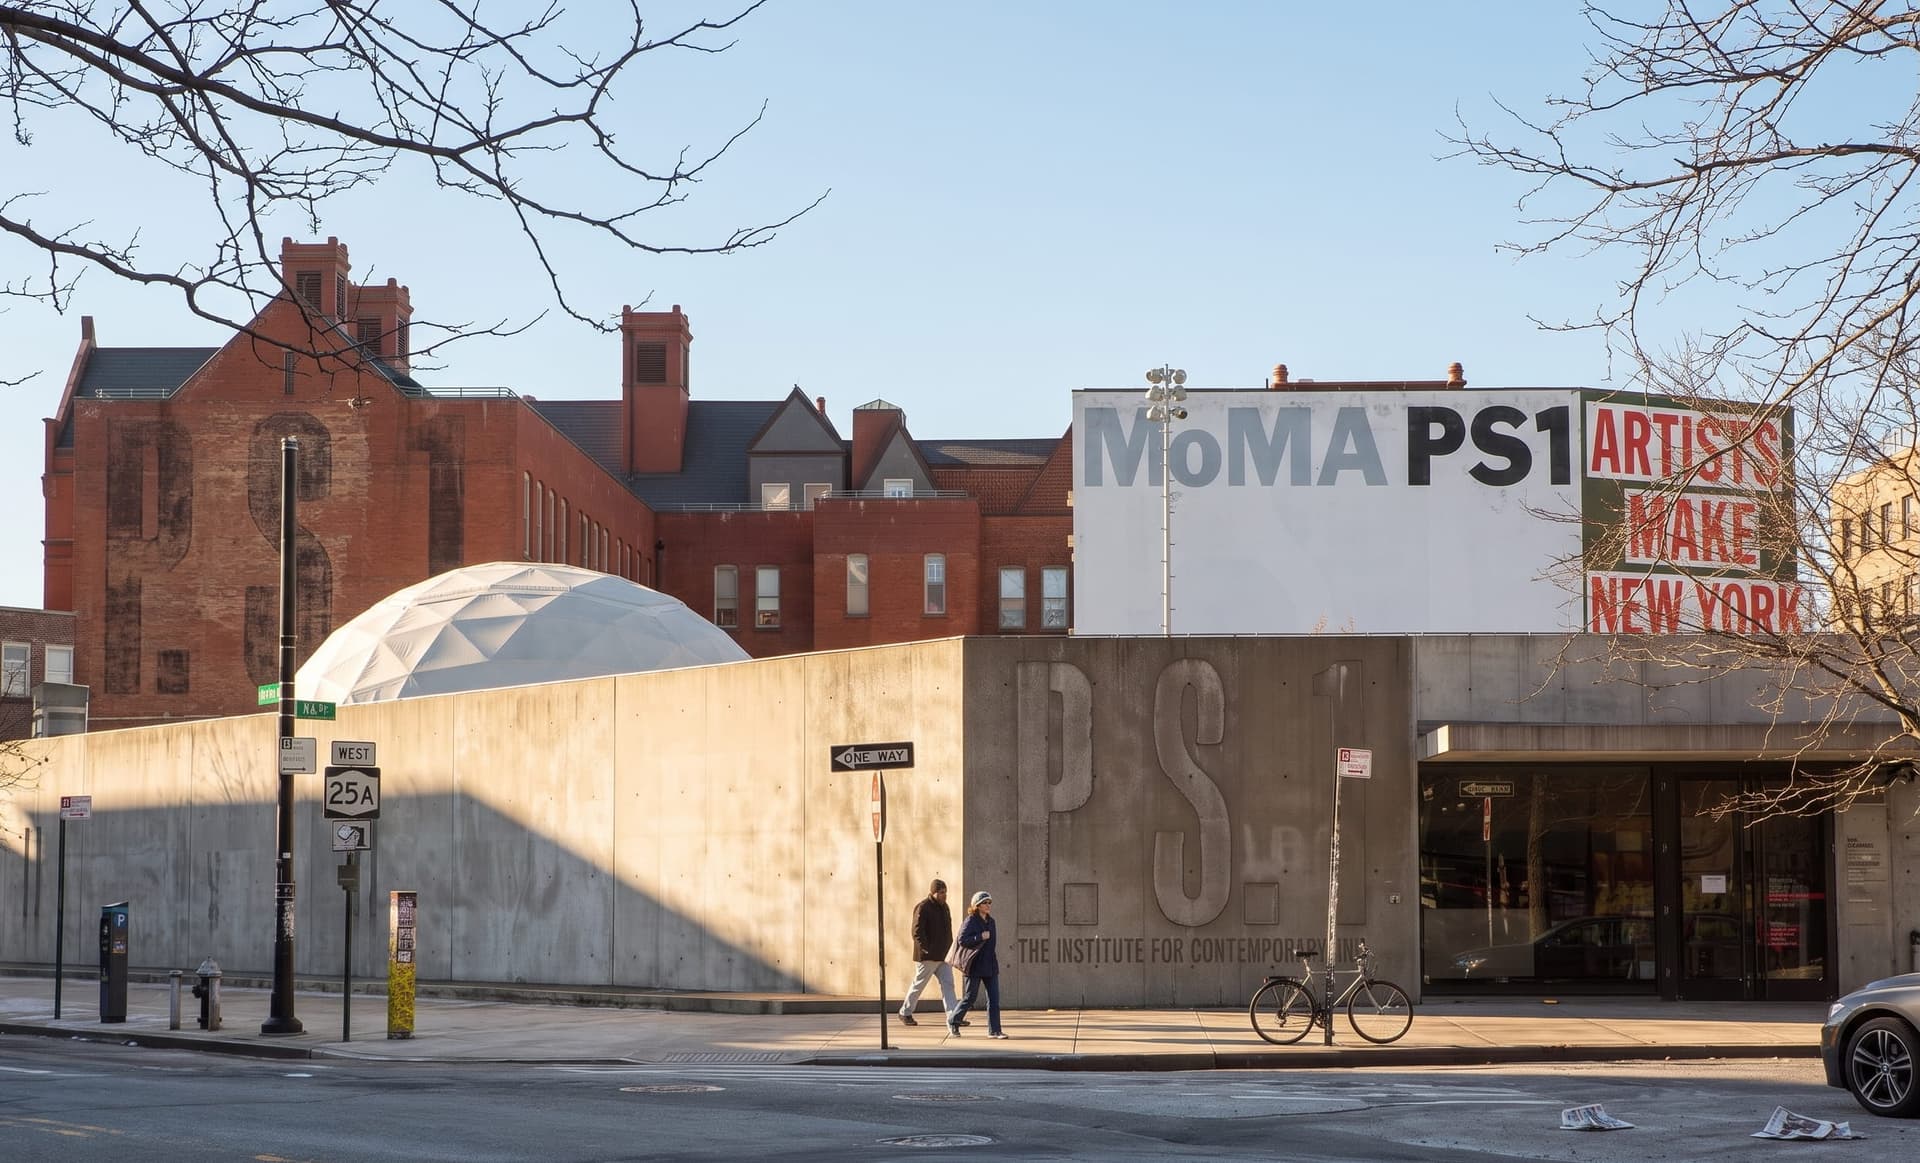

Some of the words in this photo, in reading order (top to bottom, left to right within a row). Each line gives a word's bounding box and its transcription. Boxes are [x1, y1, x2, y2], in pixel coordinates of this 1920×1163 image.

[1083, 405, 1389, 487] MoMA
[1407, 405, 1572, 487] PS1
[1591, 408, 1779, 488] ARTISTS
[1629, 494, 1757, 565] MAKE
[1591, 576, 1683, 634] NEW
[1695, 582, 1802, 635] YORK
[338, 747, 370, 760] WEST
[844, 752, 870, 763] ONE
[878, 750, 904, 761] WAY
[329, 781, 374, 806] 25A
[118, 914, 125, 927] P
[1017, 938, 1050, 963] THE
[1057, 938, 1144, 963] INSTITUTE
[1152, 938, 1183, 963] FOR
